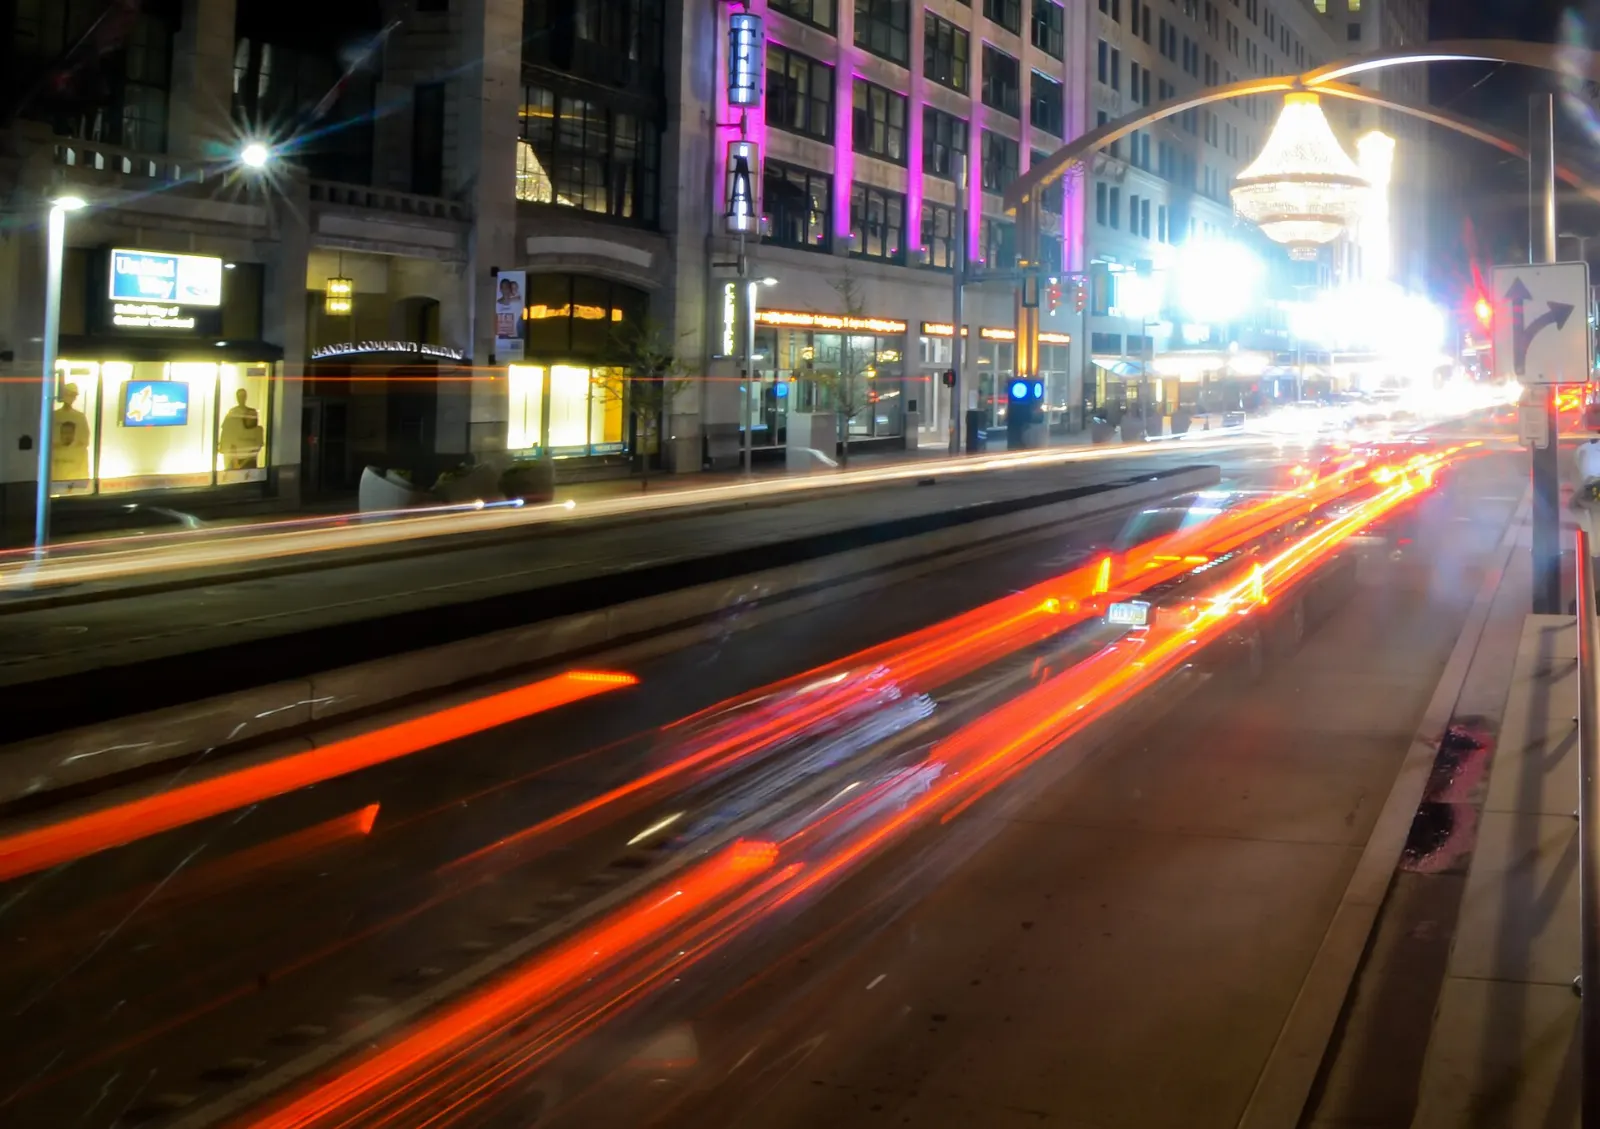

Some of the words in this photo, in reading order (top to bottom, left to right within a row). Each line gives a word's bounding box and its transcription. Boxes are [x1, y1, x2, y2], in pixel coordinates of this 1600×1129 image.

[116, 256, 175, 278] United
[357, 340, 418, 353] COMMUNITY
[420, 343, 465, 361] BUILDING
